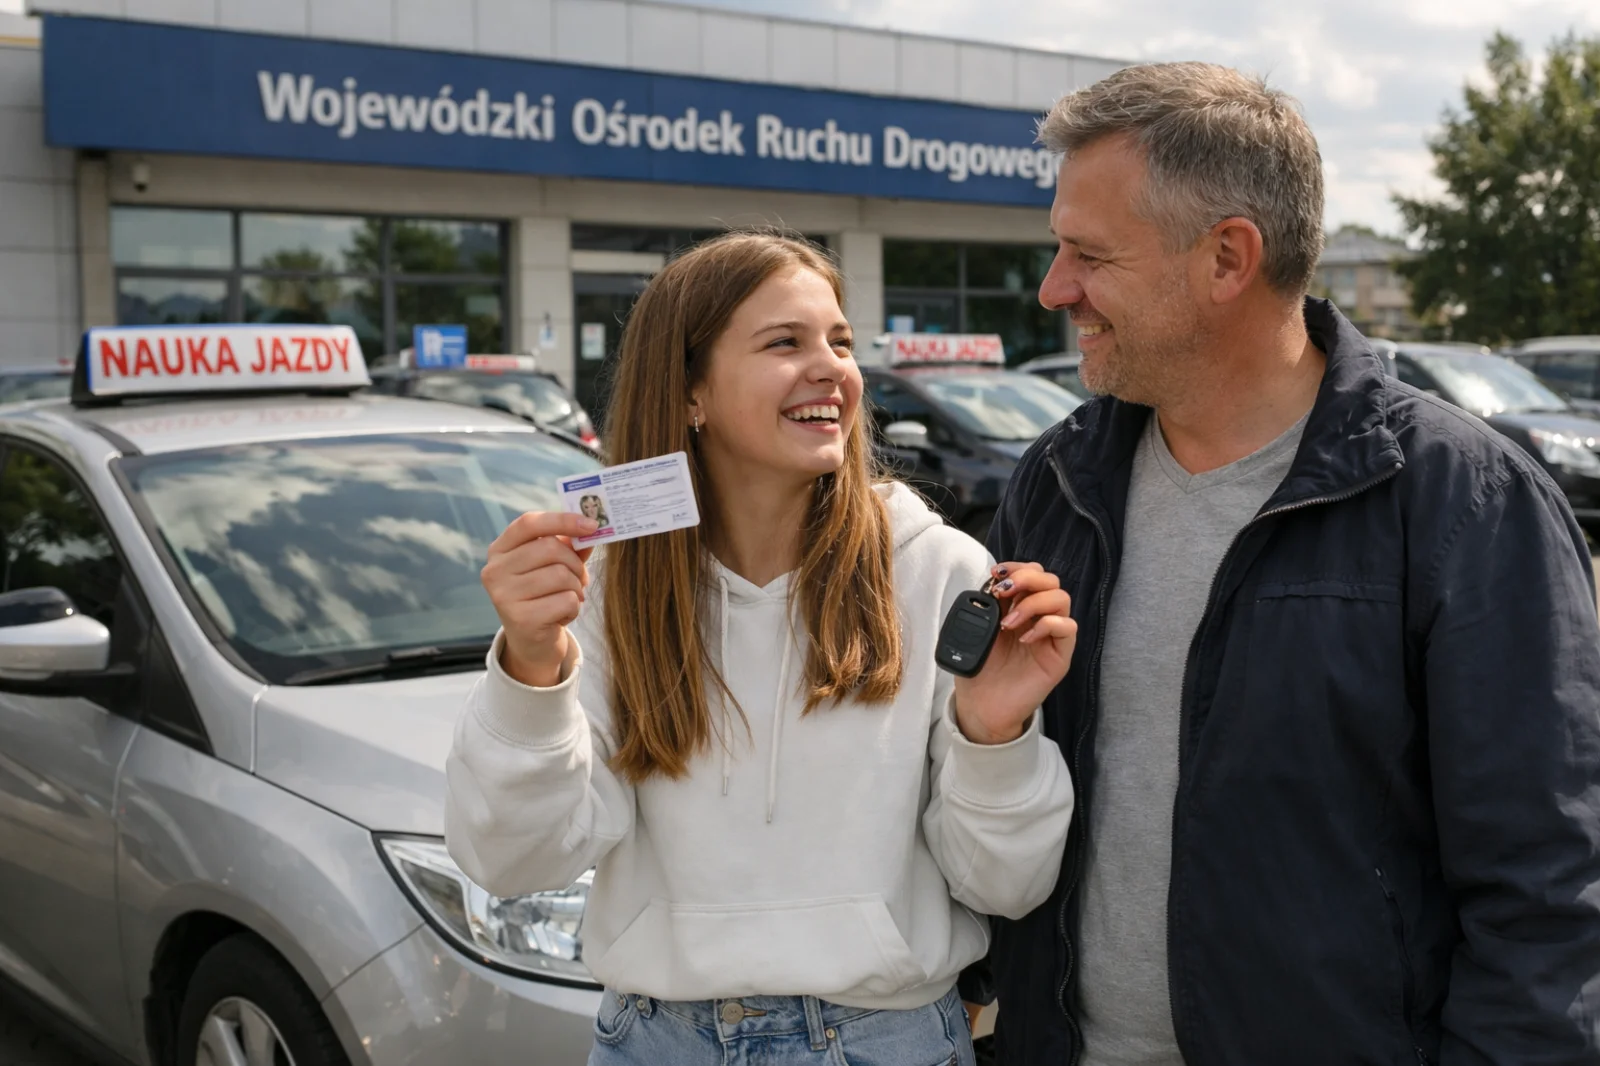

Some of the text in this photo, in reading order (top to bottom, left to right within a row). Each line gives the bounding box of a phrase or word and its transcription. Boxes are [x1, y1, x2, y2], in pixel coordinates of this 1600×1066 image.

[257, 70, 555, 142] Wojewódzki
[572, 98, 746, 156] Ośrodek
[757, 114, 873, 165] Ruchu
[97, 336, 351, 379] NAUKA JAZDY
